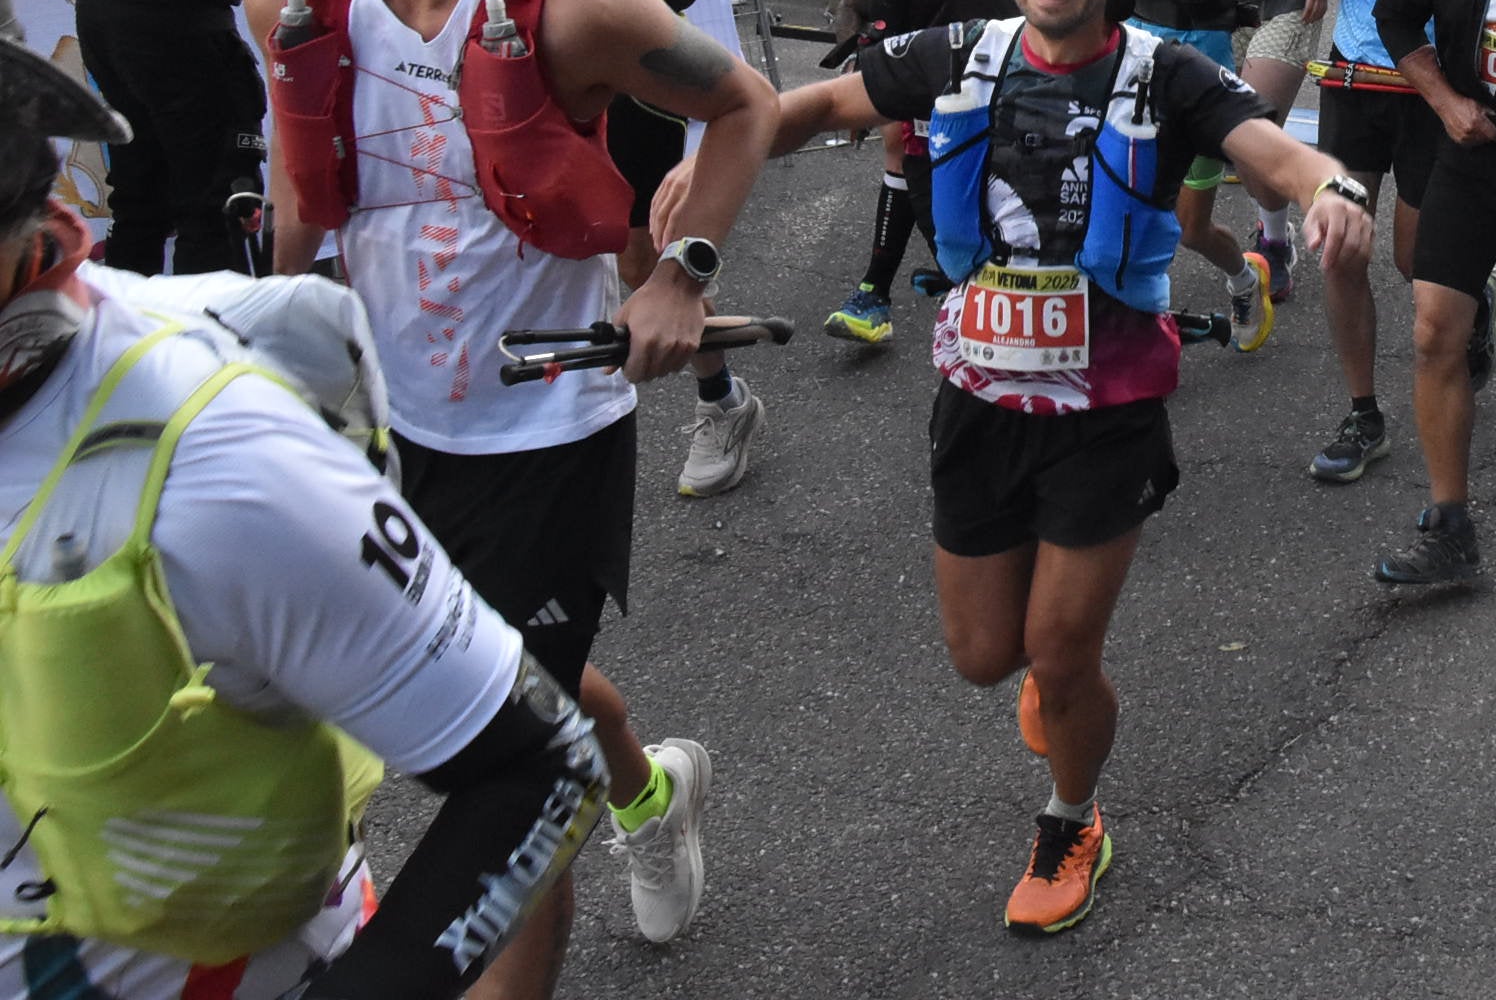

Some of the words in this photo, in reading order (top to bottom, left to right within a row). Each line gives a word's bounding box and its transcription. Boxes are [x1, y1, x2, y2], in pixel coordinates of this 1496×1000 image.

[1058, 209, 1085, 225] 202
[997, 271, 1038, 289] VETONA
[974, 289, 1068, 338] 1016
